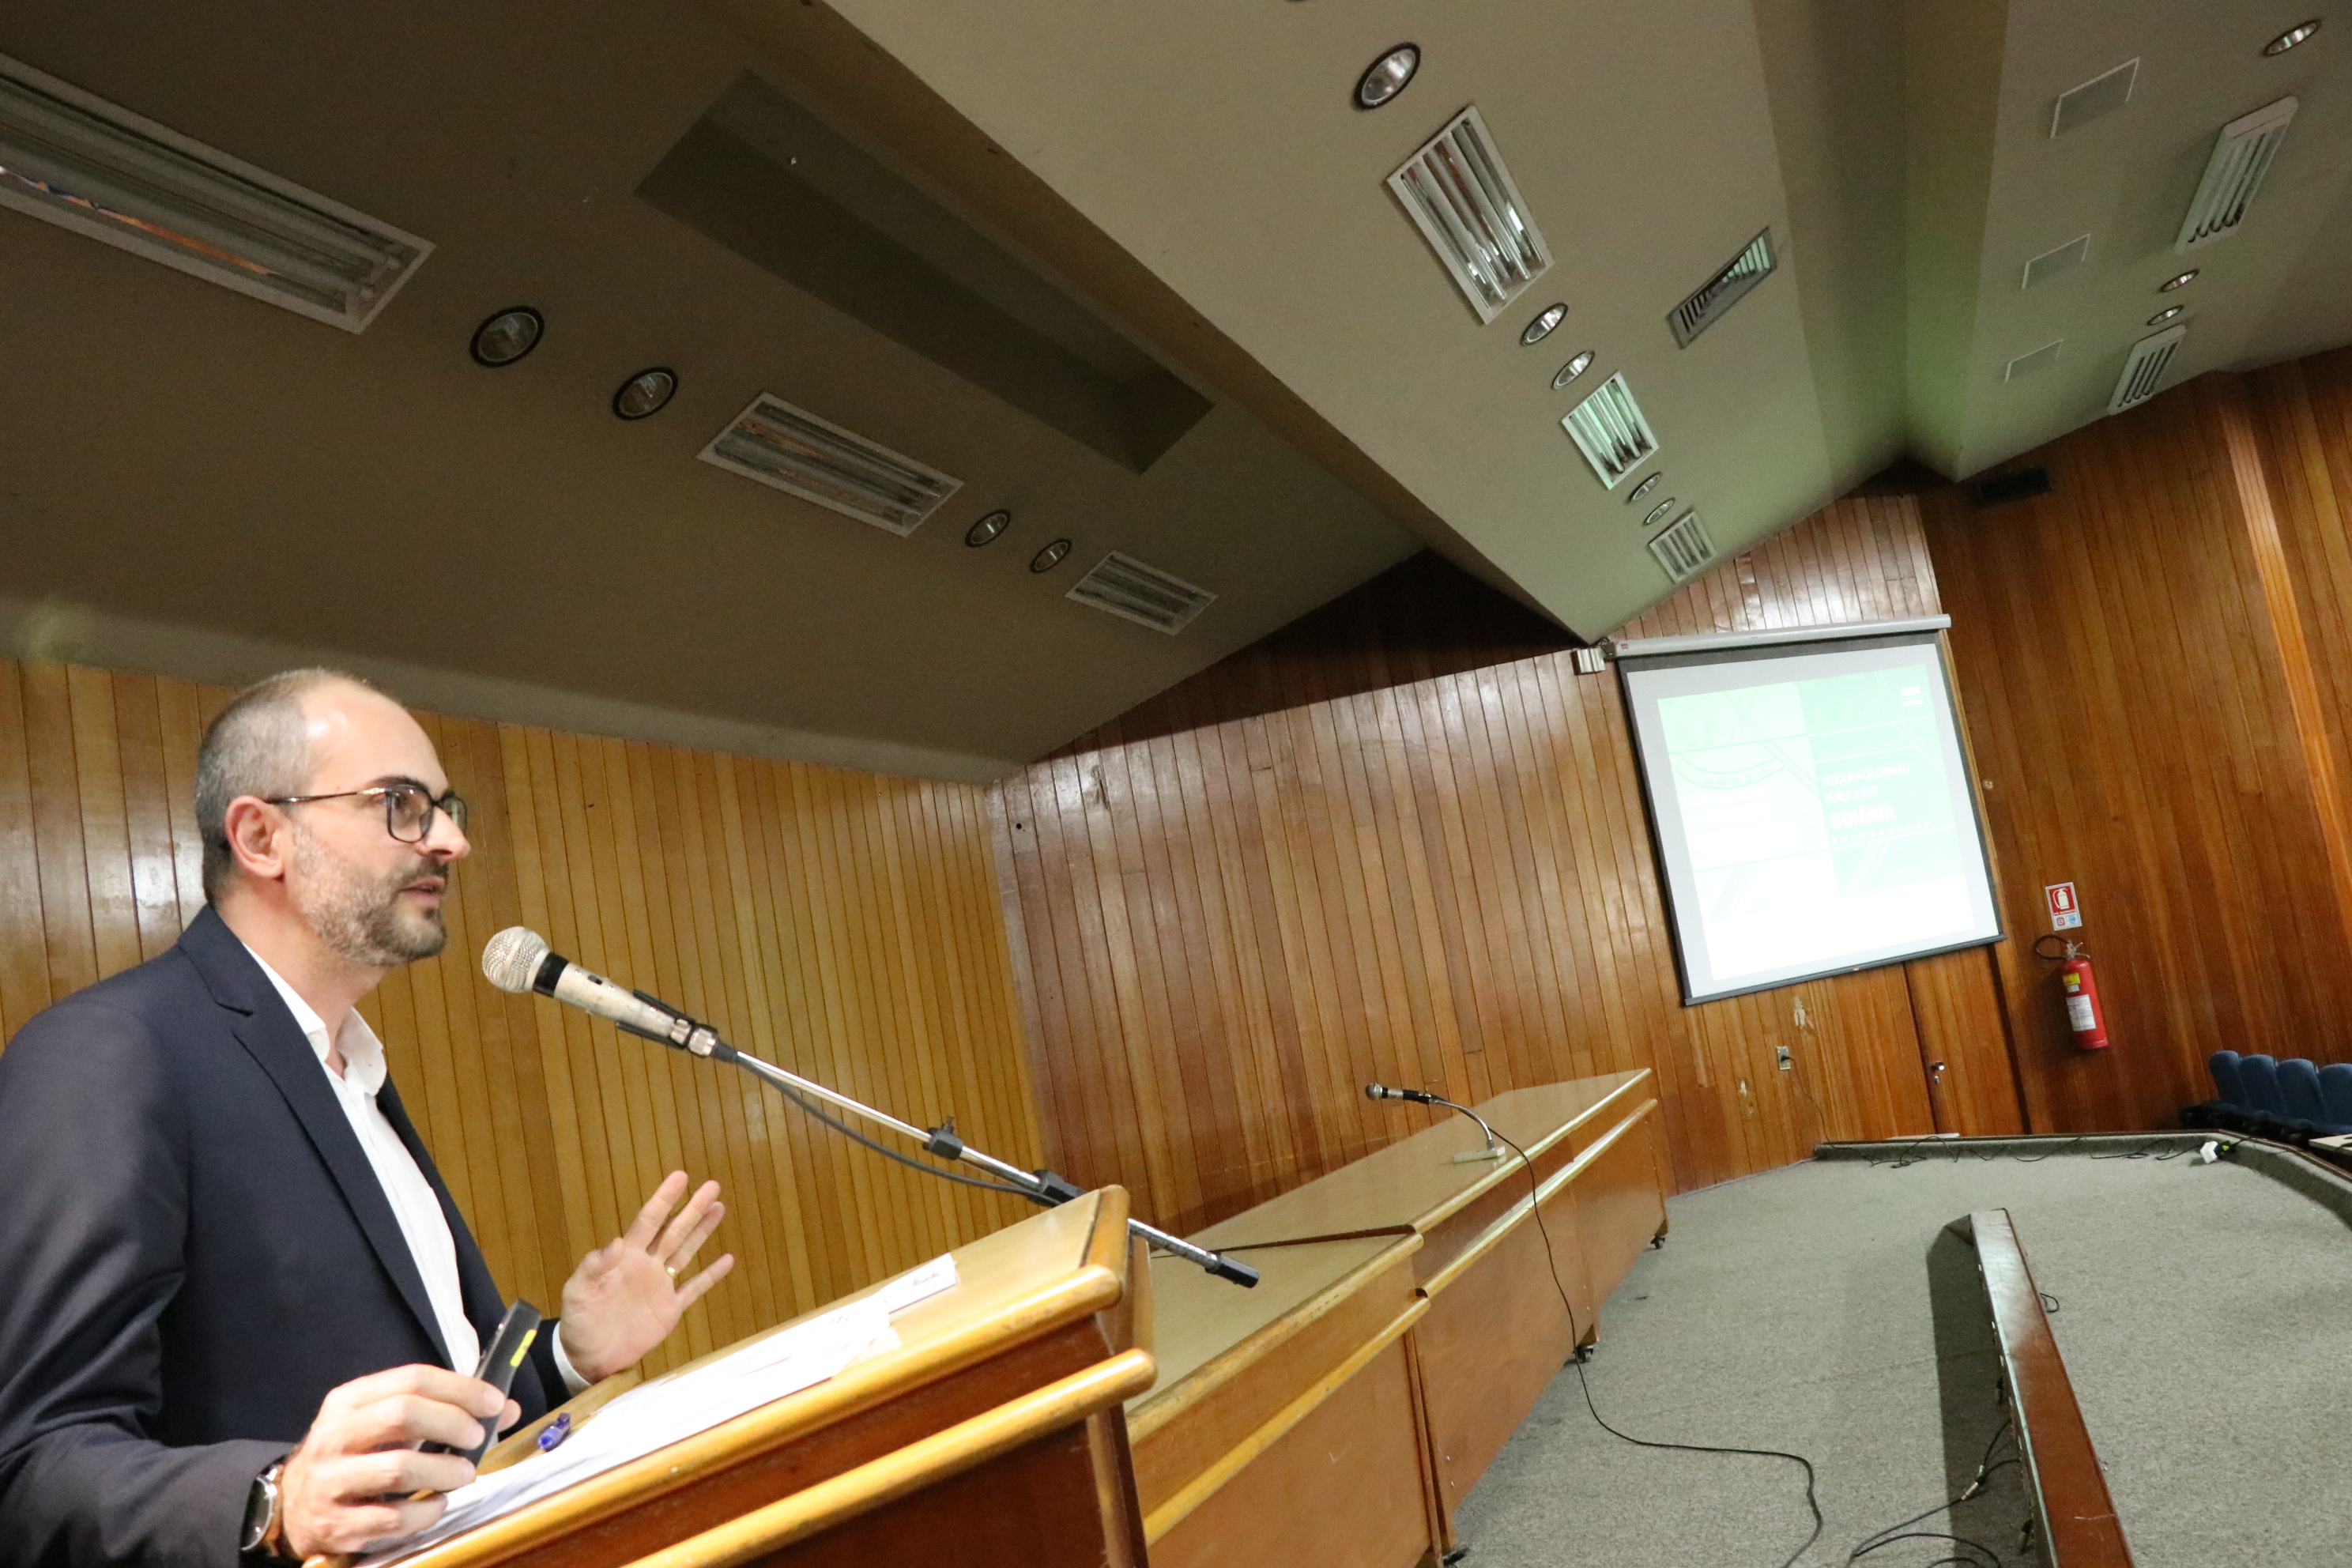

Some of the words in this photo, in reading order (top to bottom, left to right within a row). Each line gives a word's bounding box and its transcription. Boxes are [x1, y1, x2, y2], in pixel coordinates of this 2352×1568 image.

[1821, 771, 1861, 786] PESQUISA
[1863, 768, 1874, 779] DE
[1875, 762, 1910, 778] OPINIÃO
[1825, 789, 1860, 803] PÚBLICA
[1860, 785, 1879, 798] 2017
[1830, 804, 1896, 829] GOIÂNIA
